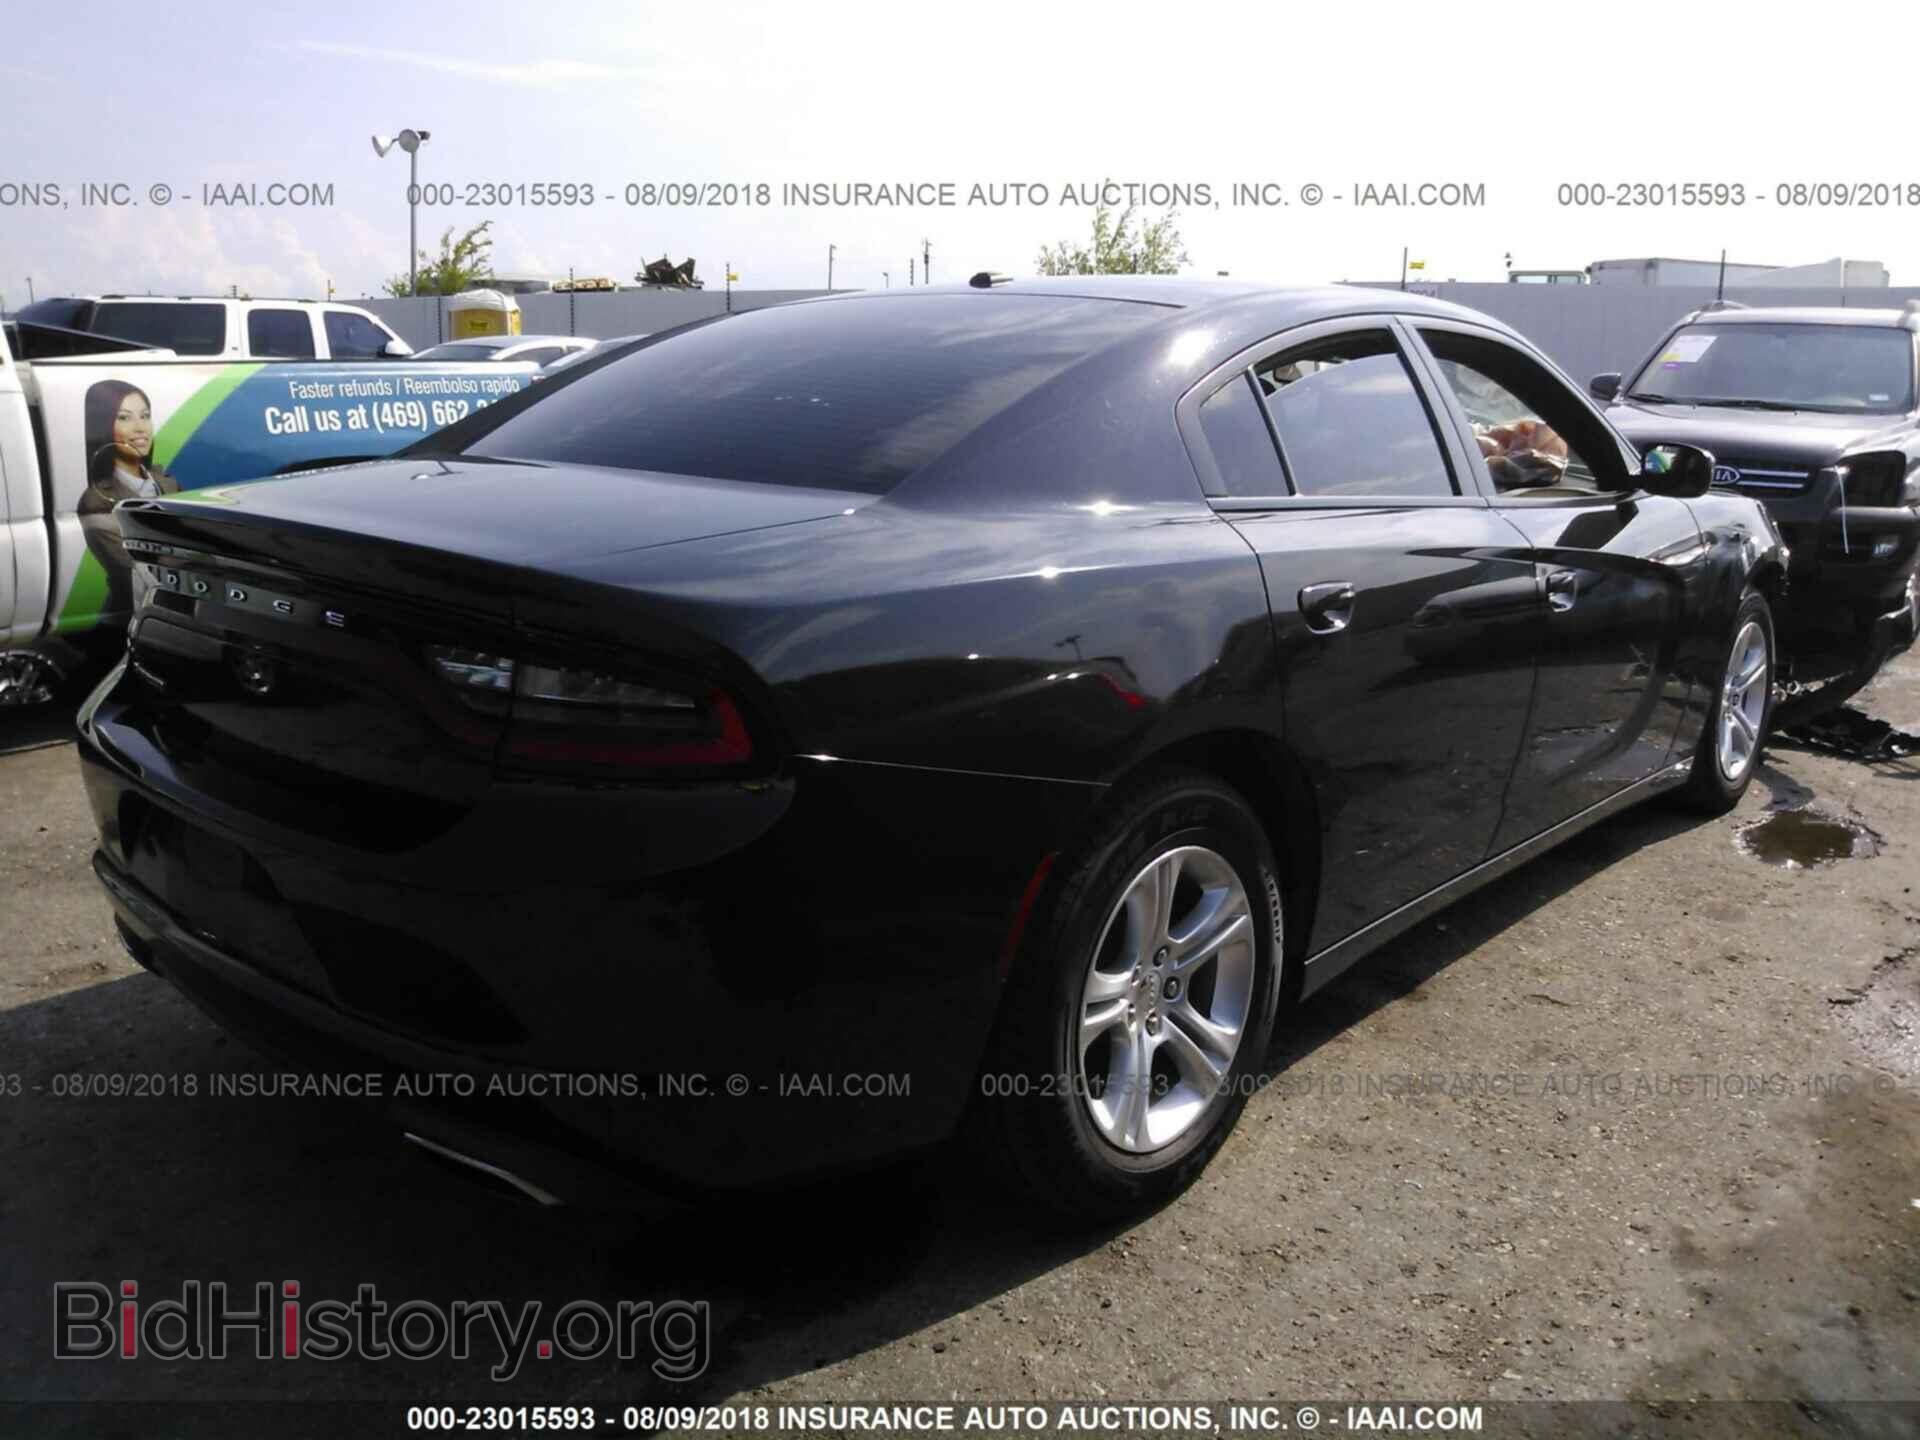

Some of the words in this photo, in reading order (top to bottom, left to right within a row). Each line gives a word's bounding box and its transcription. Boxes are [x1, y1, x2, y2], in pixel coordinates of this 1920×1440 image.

[288, 381, 335, 400] Faster
[340, 378, 393, 398] refunds
[403, 377, 479, 396] Reembolso
[481, 376, 521, 396] rapido
[264, 405, 310, 435] Call
[314, 410, 341, 432] us
[344, 408, 369, 430] at
[373, 399, 427, 433] (469)
[167, 572, 346, 628] DODGE
